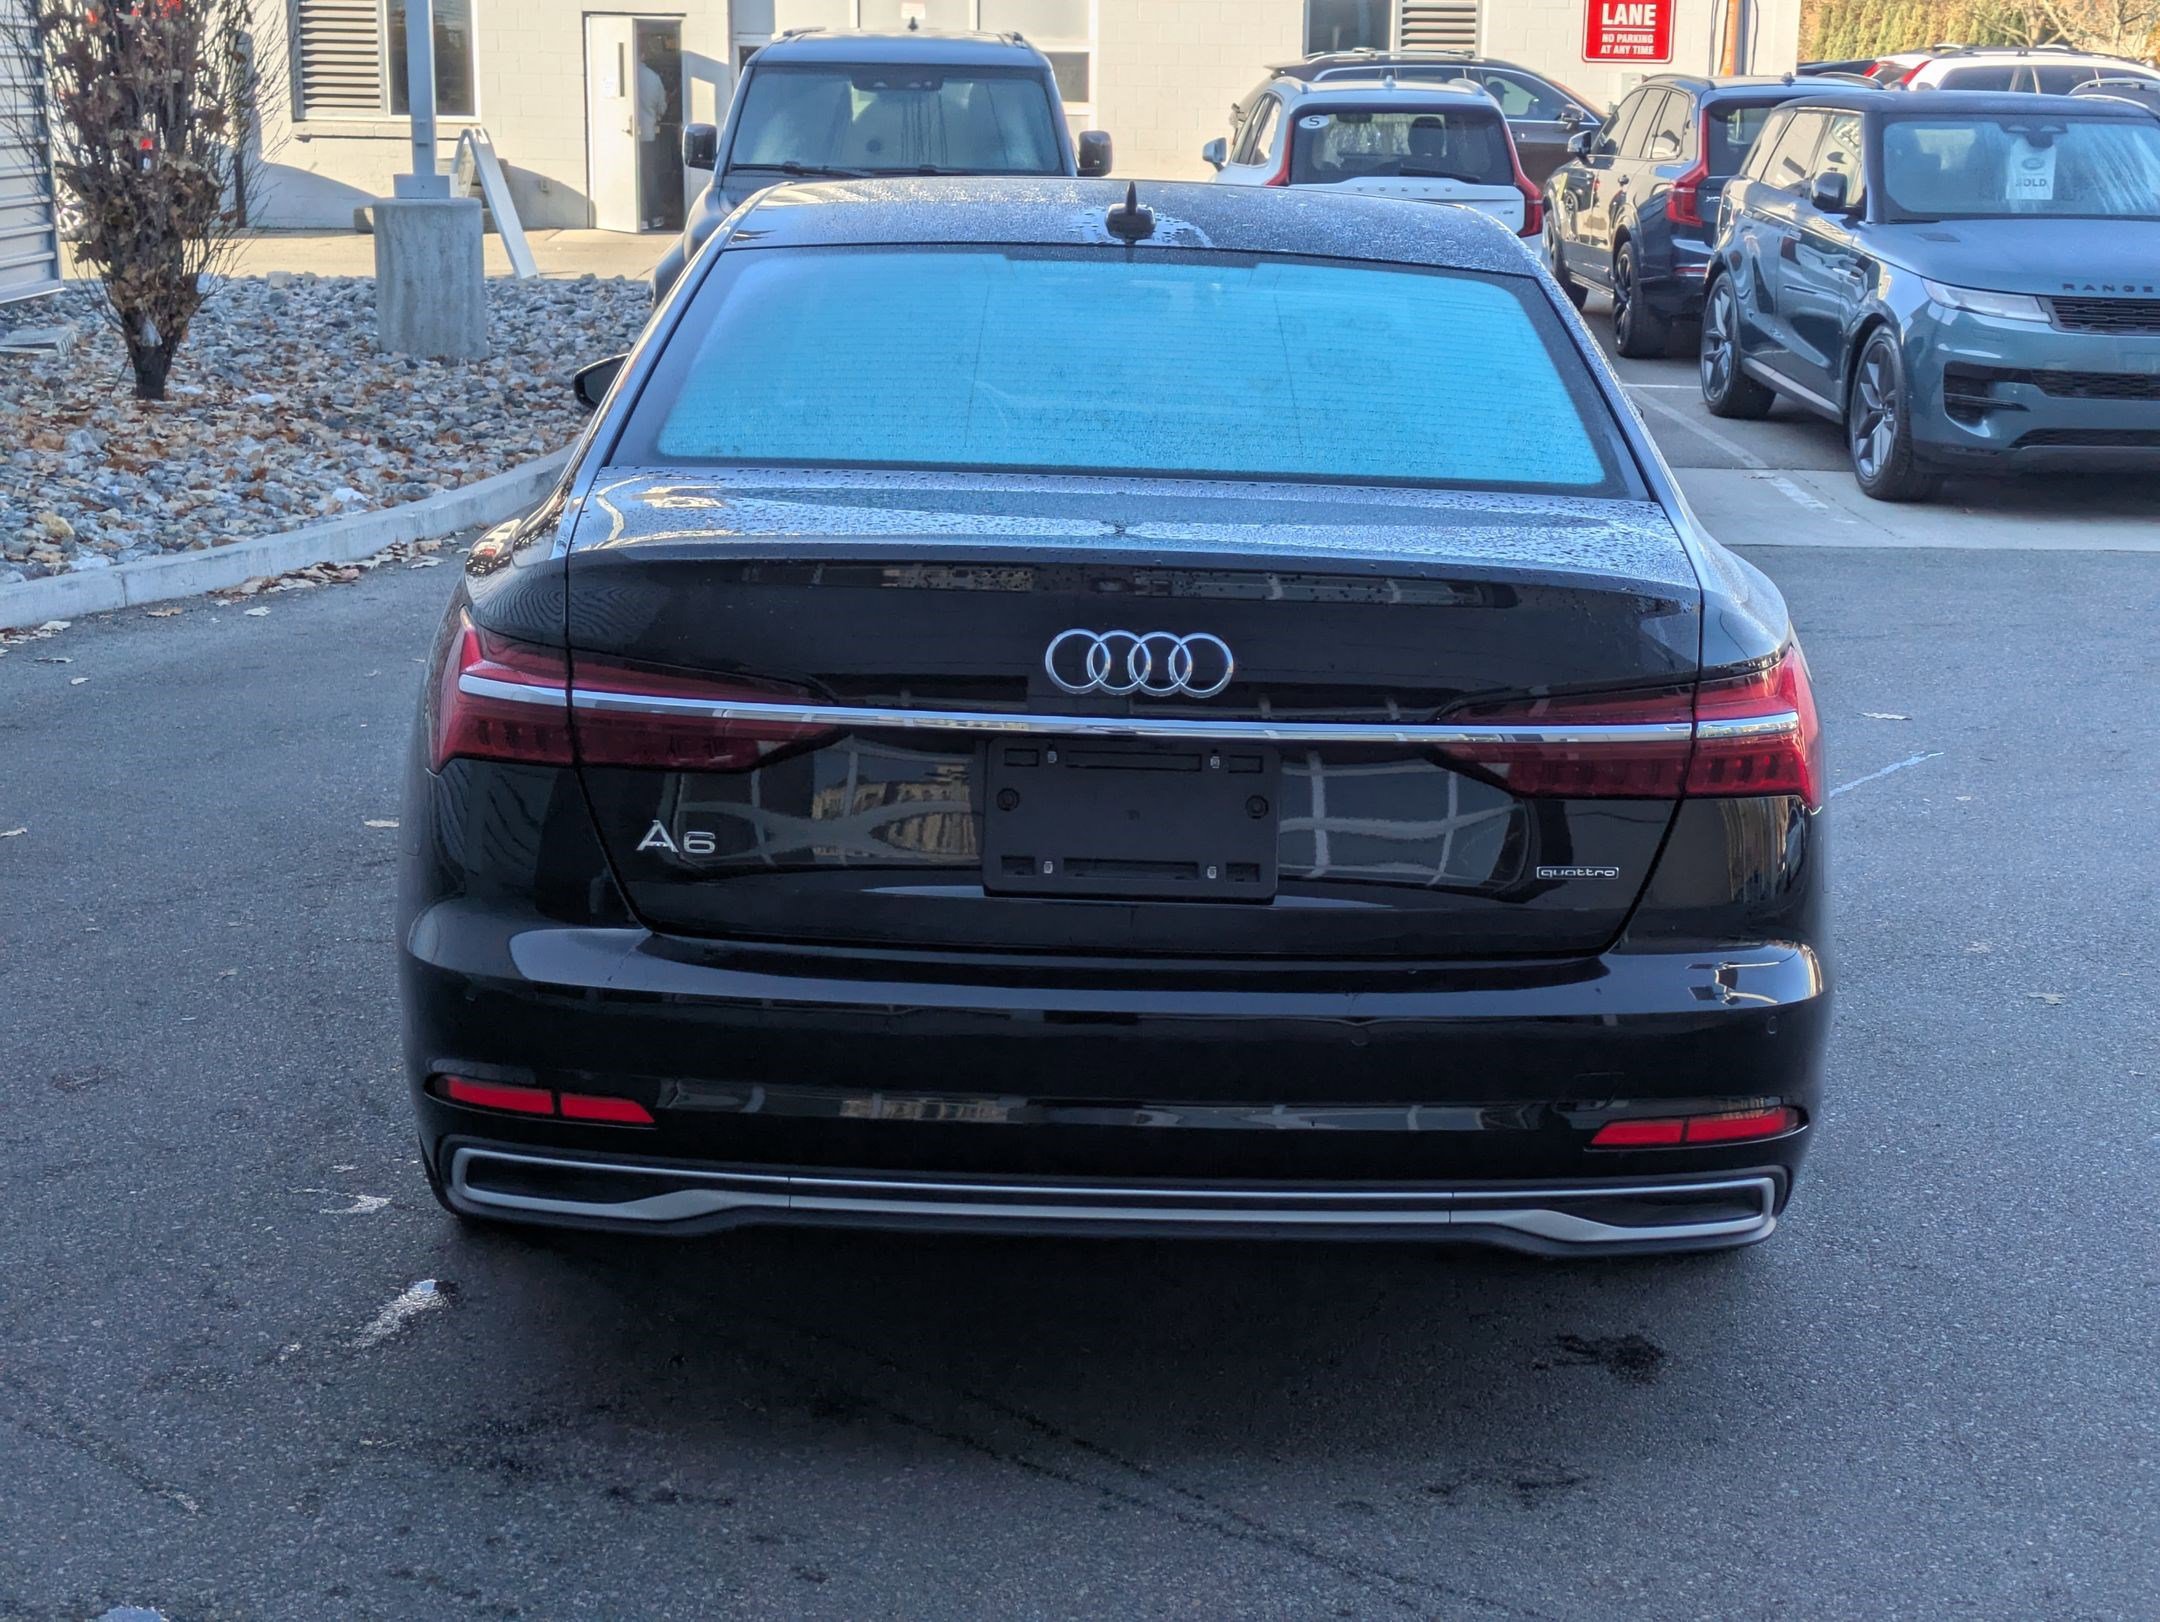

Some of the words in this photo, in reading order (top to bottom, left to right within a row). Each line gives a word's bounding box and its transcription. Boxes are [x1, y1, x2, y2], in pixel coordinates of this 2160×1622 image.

[1602, 3, 1657, 26] LANE
[1602, 33, 1615, 43] NO
[1616, 33, 1654, 44] PARKING
[1600, 45, 1612, 54] AT
[1613, 45, 1631, 54] ANY
[1632, 45, 1655, 55] TIME
[1309, 116, 1320, 127] S
[2062, 283, 2154, 294] RANGE
[636, 819, 716, 854] A6
[1540, 868, 1616, 878] quattro
